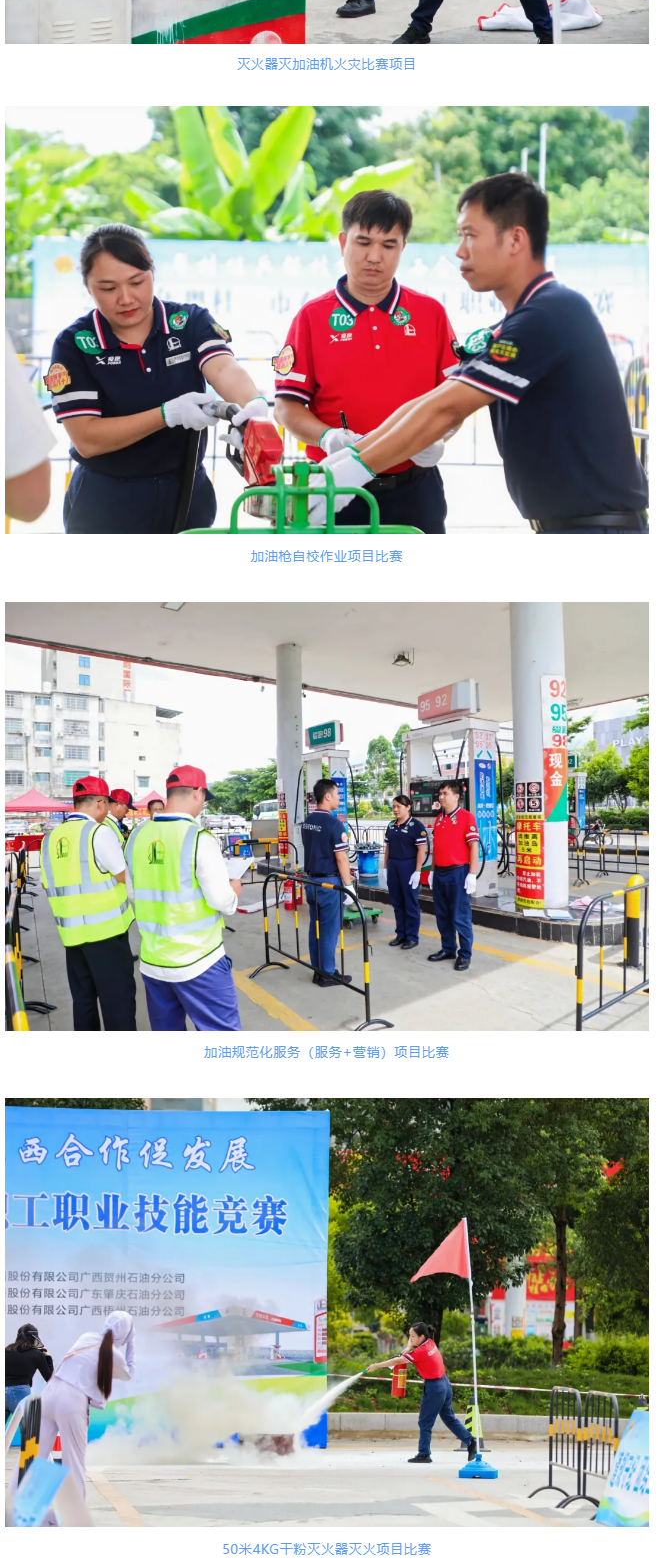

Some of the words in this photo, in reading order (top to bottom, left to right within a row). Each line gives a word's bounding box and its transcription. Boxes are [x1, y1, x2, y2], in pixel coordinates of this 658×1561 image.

[331, 313, 354, 327] T03
[420, 698, 431, 713] 95
[435, 693, 448, 708] 92
[612, 736, 643, 748] PLAY
[548, 752, 563, 787] 现金
[18, 1132, 256, 1173] 西合作促发展
[5, 1270, 185, 1284] 股份有限公司广西贺州石油分公司
[5, 1287, 185, 1301] 股份有限公司广东肇庆石油分公司
